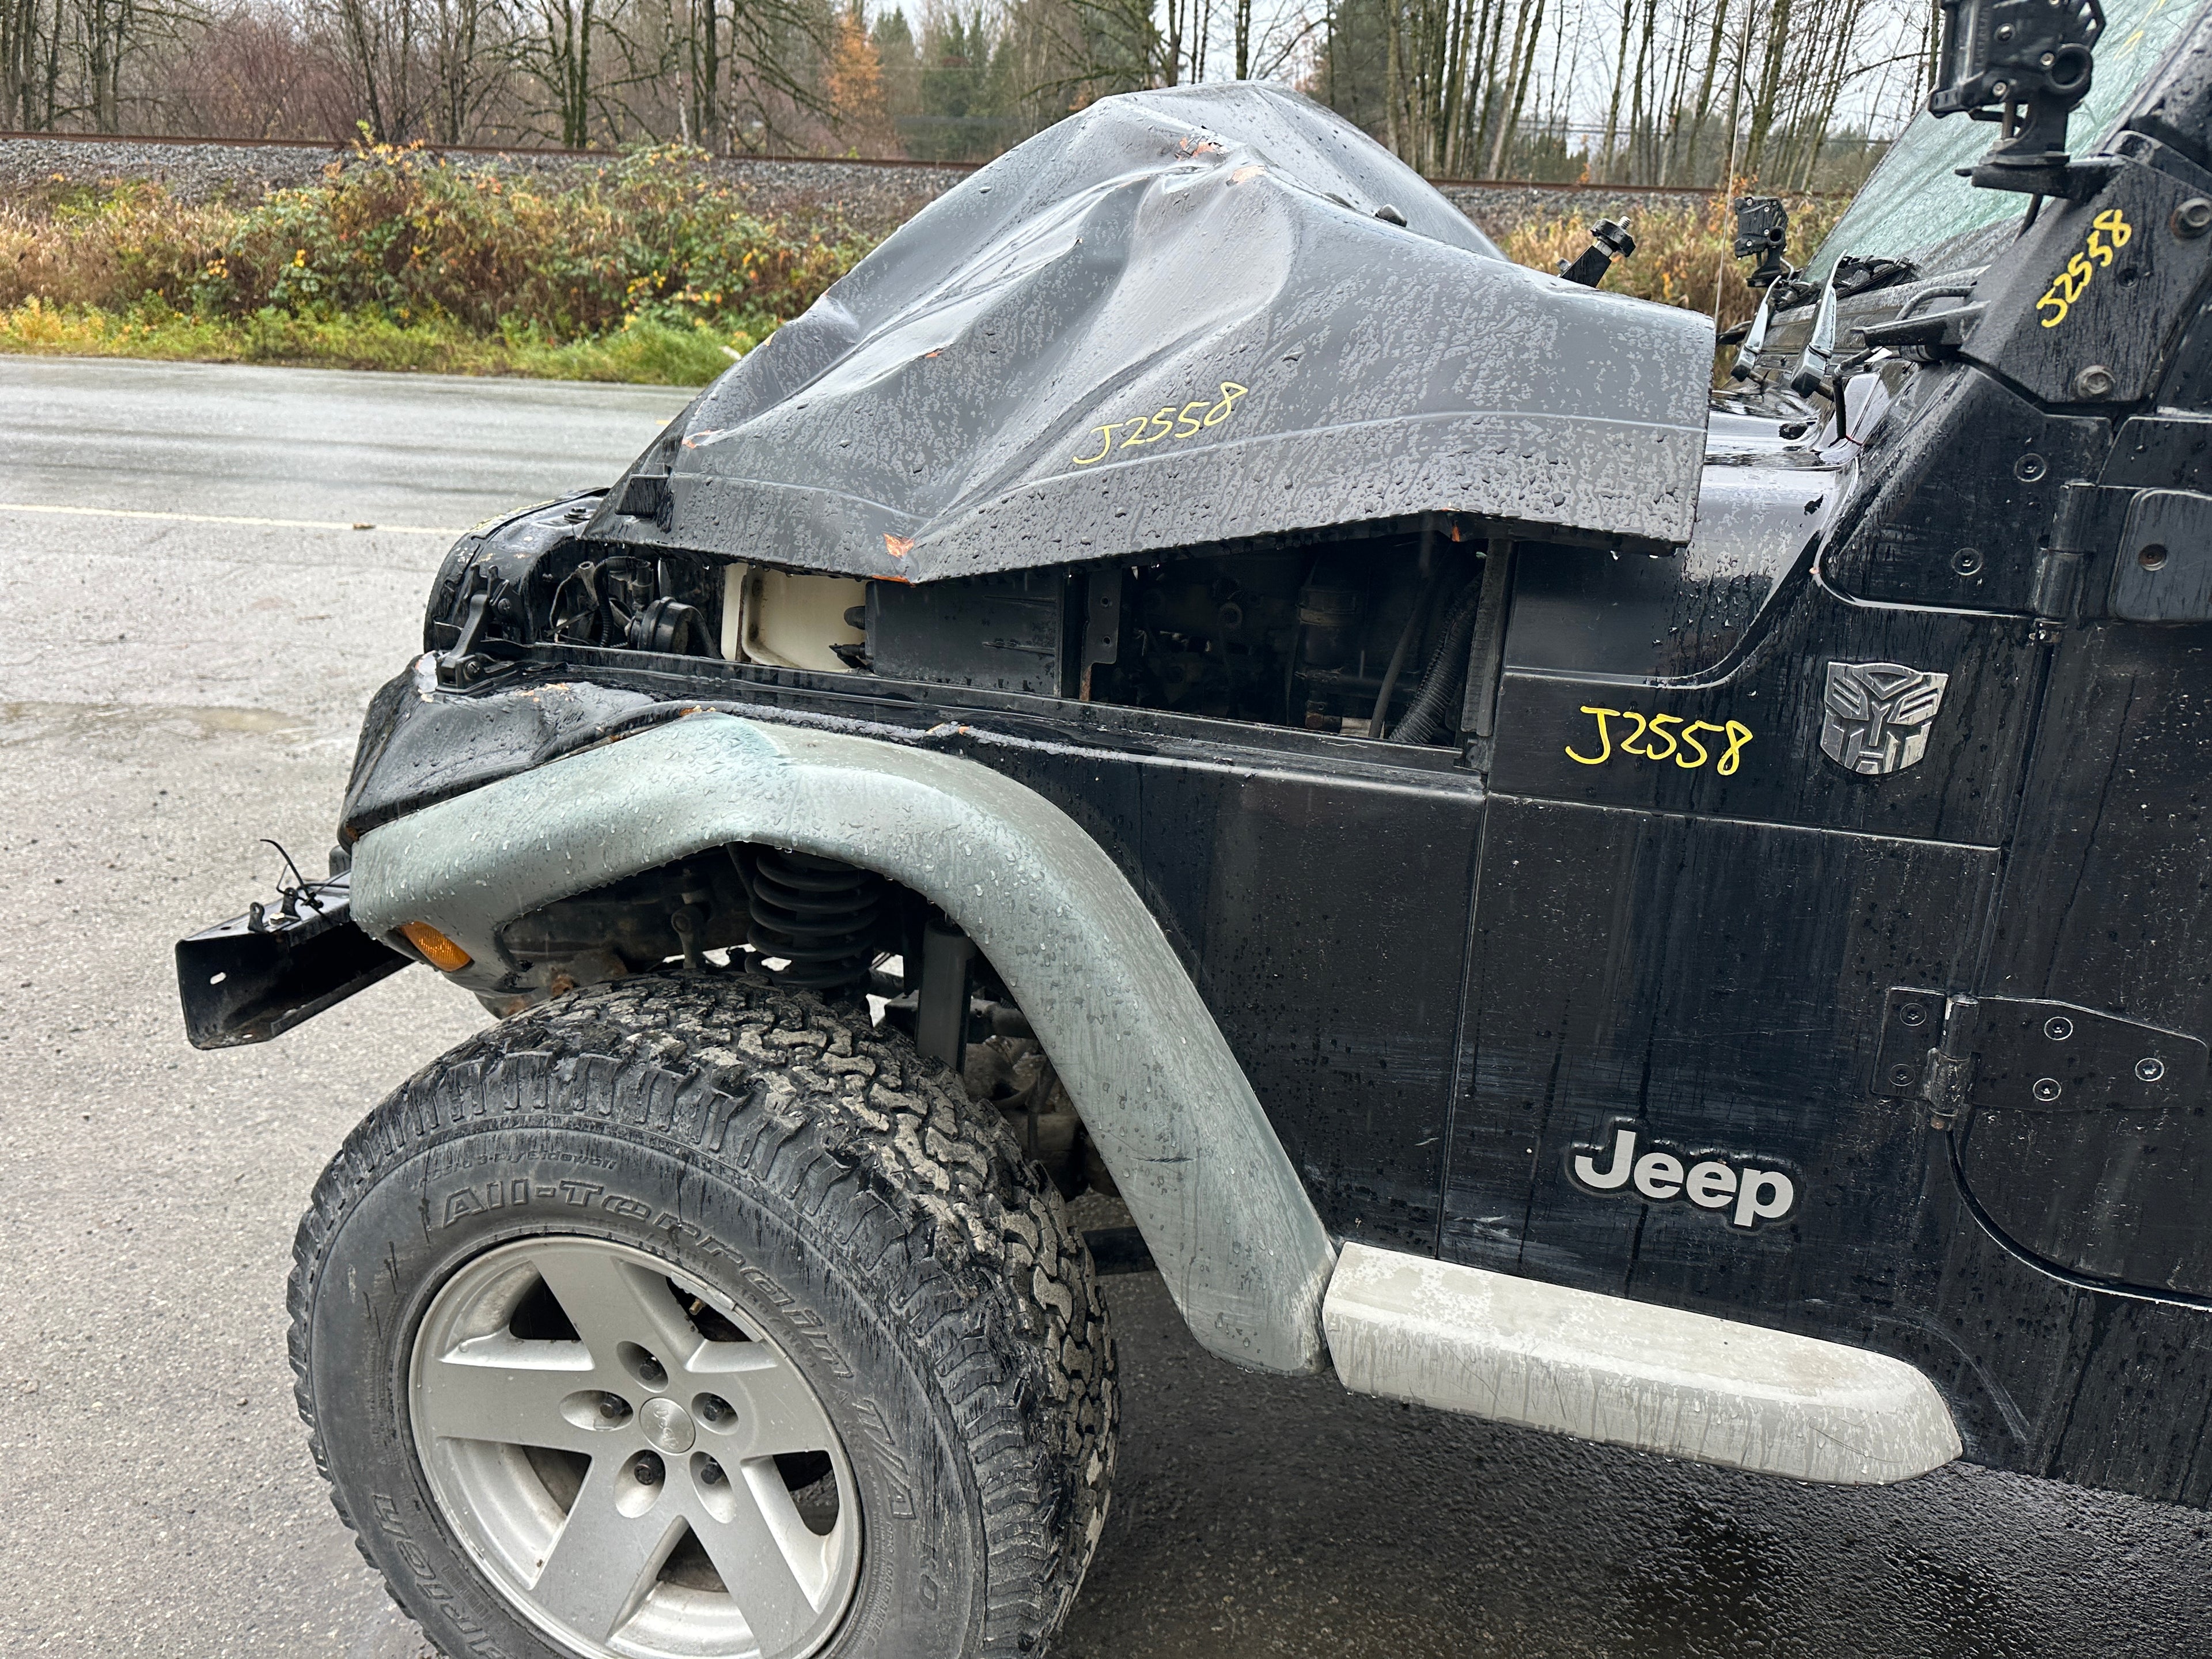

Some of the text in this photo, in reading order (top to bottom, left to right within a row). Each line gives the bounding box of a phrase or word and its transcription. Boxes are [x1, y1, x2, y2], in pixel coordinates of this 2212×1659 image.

[2036, 209, 2132, 328] J2558
[1073, 381, 1248, 464] J2558
[1565, 706, 1753, 775] J2558
[1575, 1130, 1794, 1227] Jeep
[442, 1178, 854, 1379] All-Terrain
[851, 1397, 917, 1520] T/A
[652, 1403, 679, 1449] Jeep
